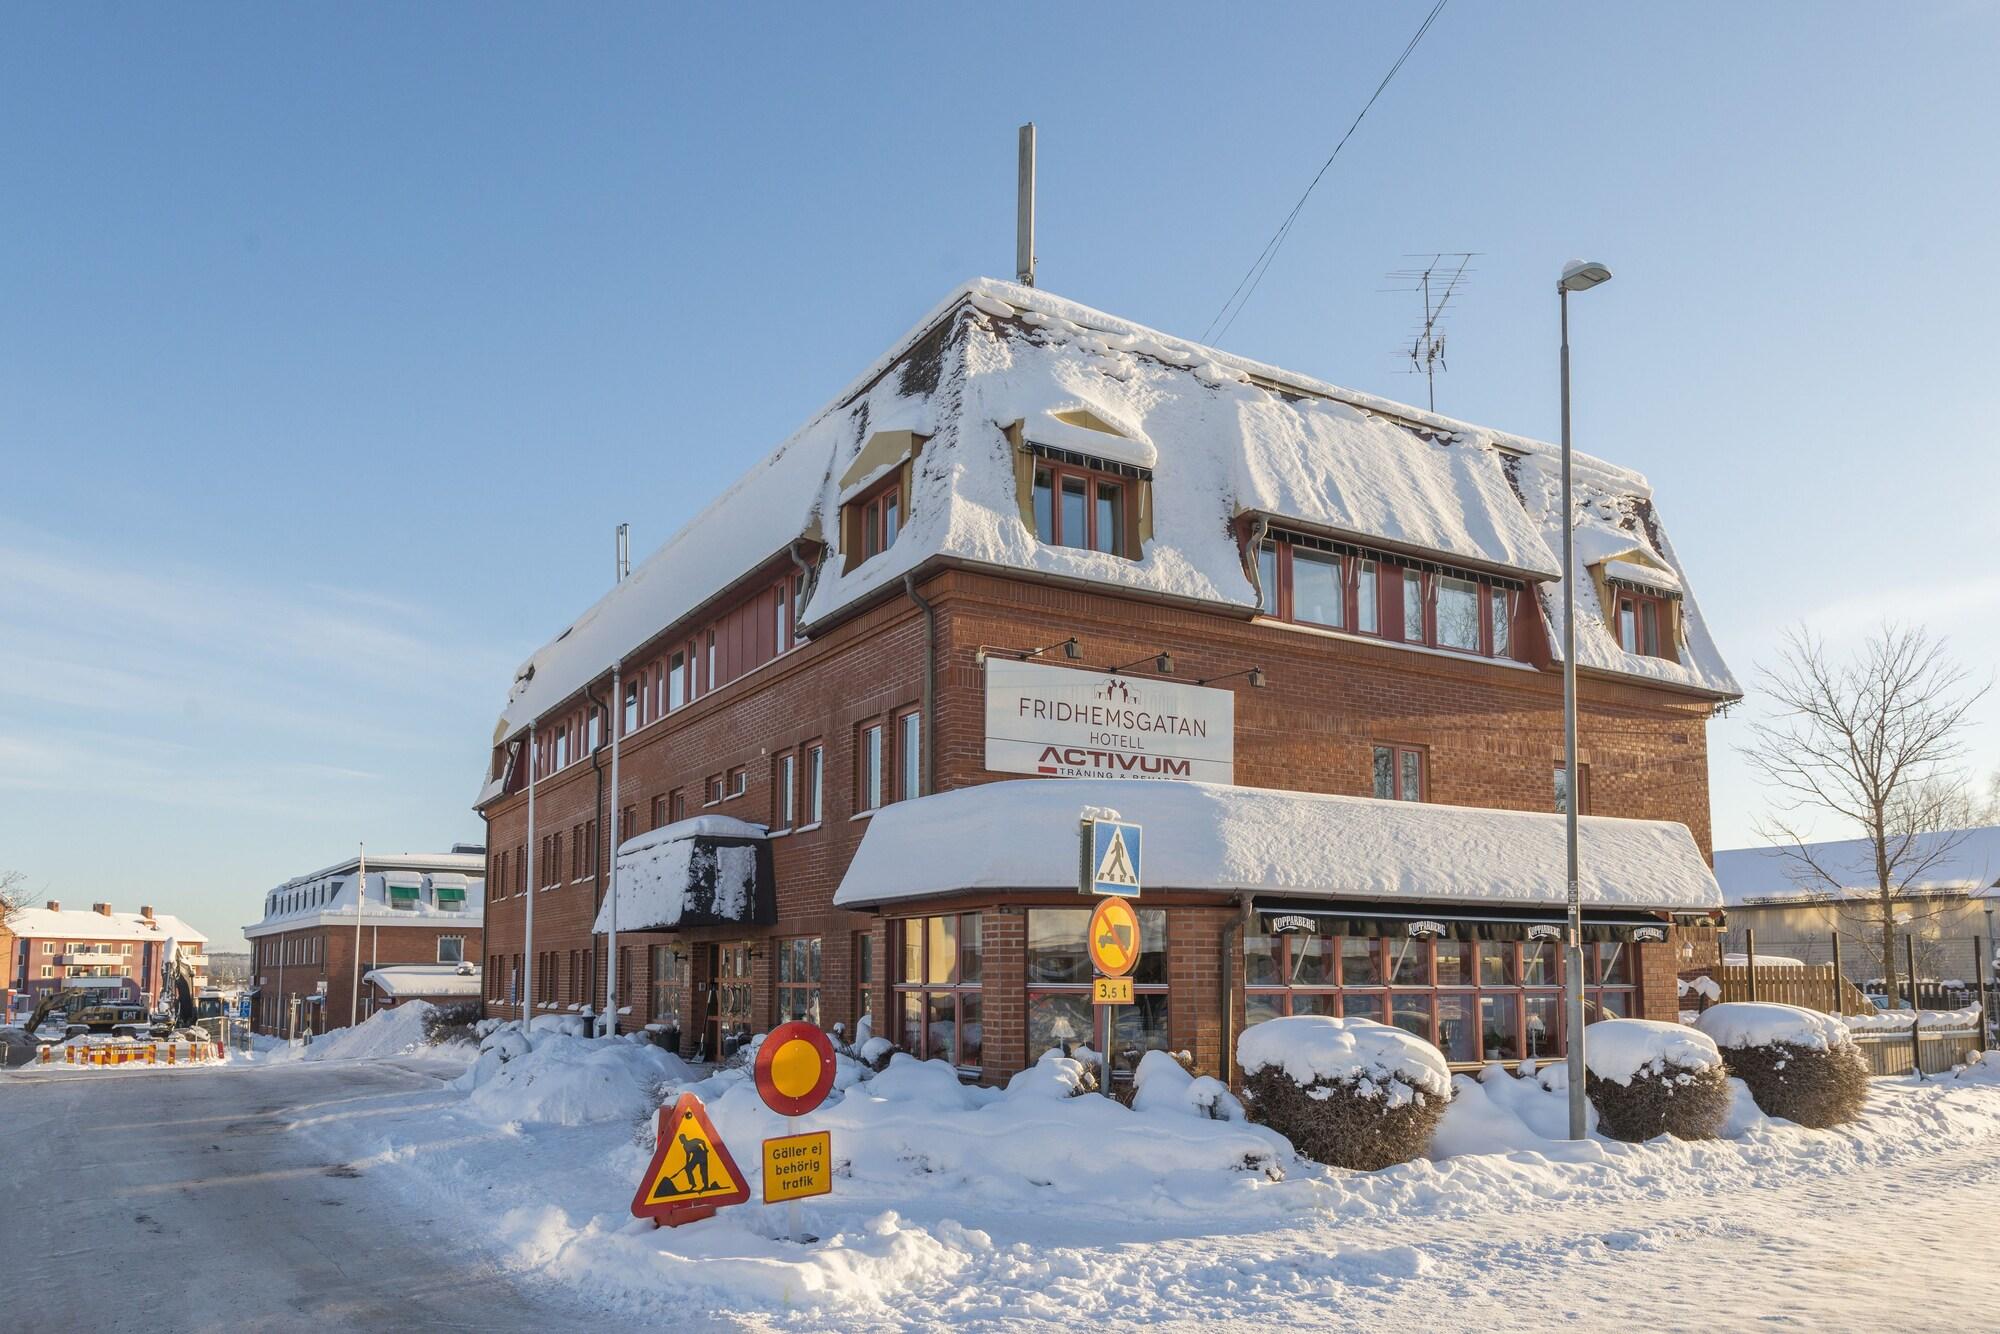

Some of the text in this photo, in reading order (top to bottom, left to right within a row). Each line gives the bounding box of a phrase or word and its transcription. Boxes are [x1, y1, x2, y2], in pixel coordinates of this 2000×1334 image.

[1019, 697, 1207, 738] FRIDHEMSGATAN
[1090, 731, 1145, 750] HOTELL
[1038, 746, 1191, 777] ACTIVUM
[1060, 768, 1113, 779] TRÄNING
[1273, 915, 1316, 933] KOPPARBERG
[1408, 920, 1446, 936] KOPPARBERG
[1122, 984, 1127, 998] t
[122, 1011, 137, 1020] CAT
[773, 1142, 822, 1160] Gäller ej
[775, 1160, 820, 1176] behörig
[782, 1175, 814, 1190] trafik
